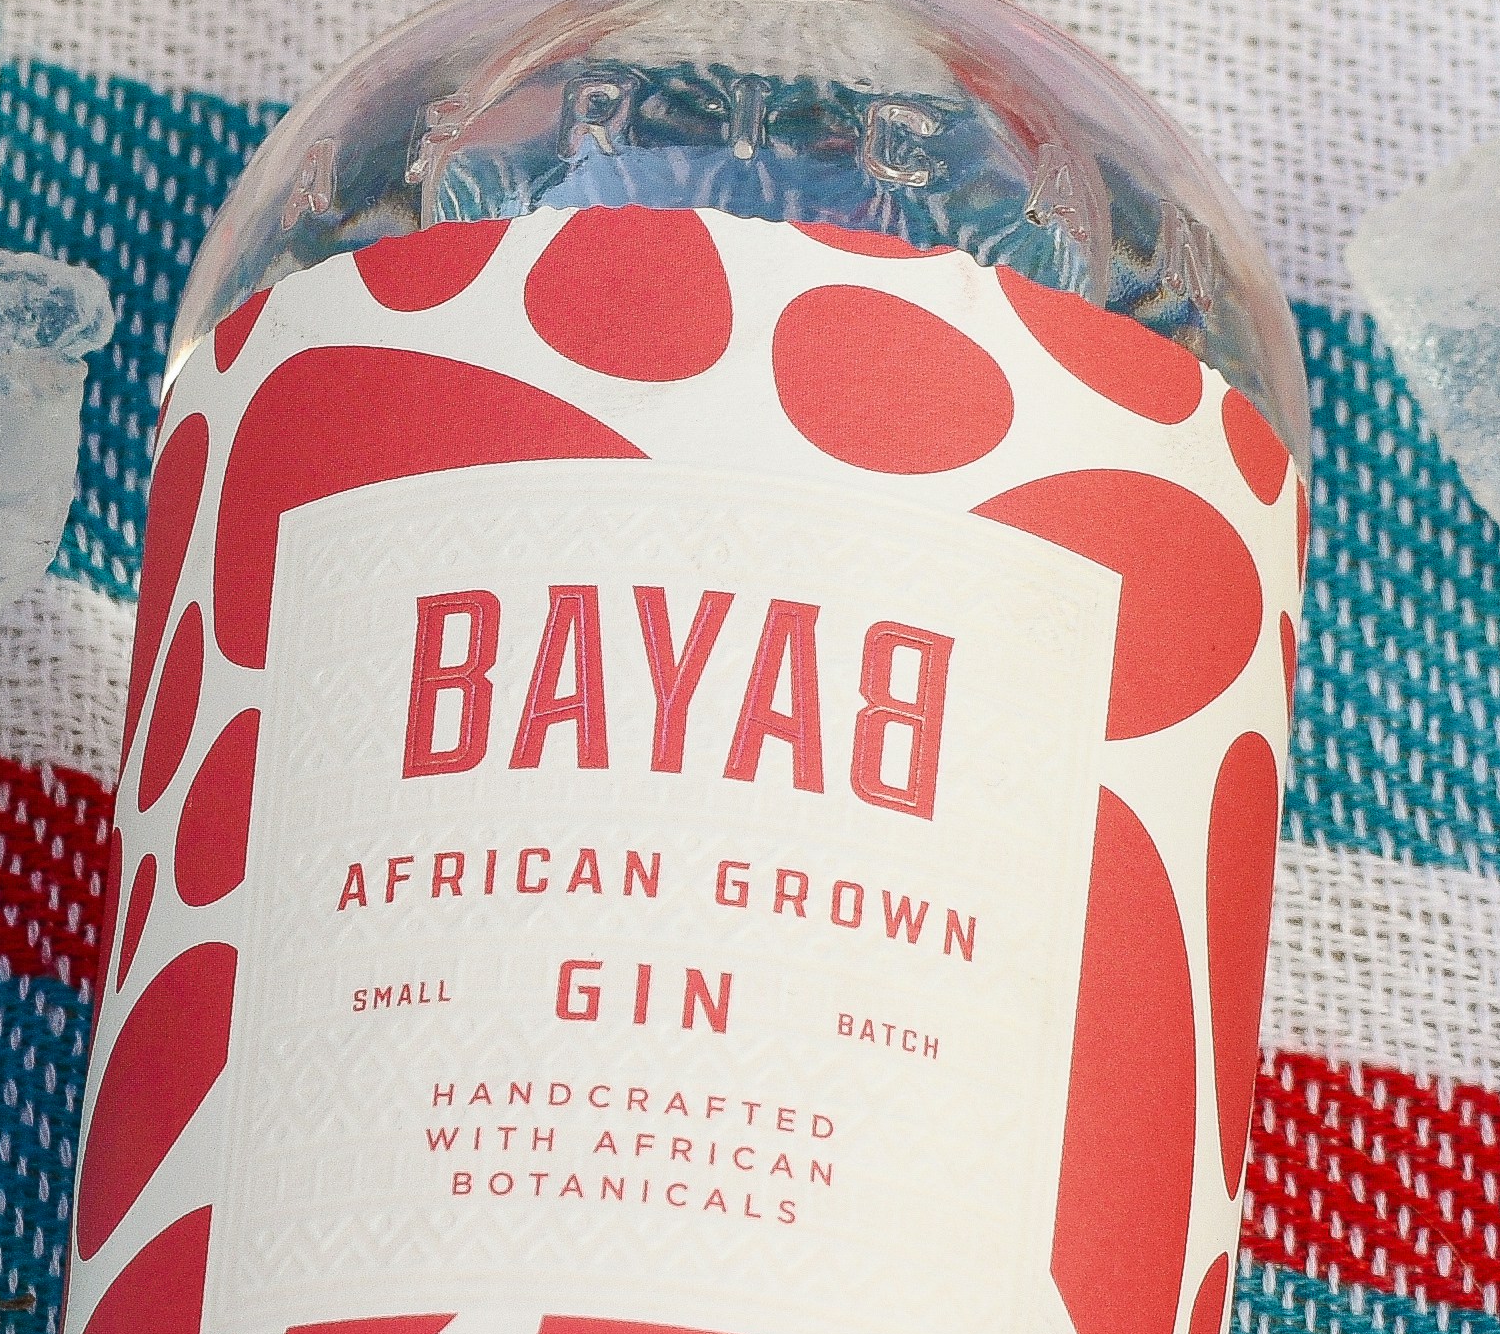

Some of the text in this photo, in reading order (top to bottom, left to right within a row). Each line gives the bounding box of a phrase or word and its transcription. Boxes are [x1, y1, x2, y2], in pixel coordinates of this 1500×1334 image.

[402, 585, 955, 821] BAYAB
[337, 848, 976, 961] AFRICAN GROWN
[353, 980, 938, 1059] SMALL BATCH
[556, 959, 732, 1034] GIN
[433, 1082, 833, 1138] HANDCRAFTED
[426, 1127, 832, 1186] WITH AFRICAN
[452, 1172, 795, 1224] BOTANICALS
